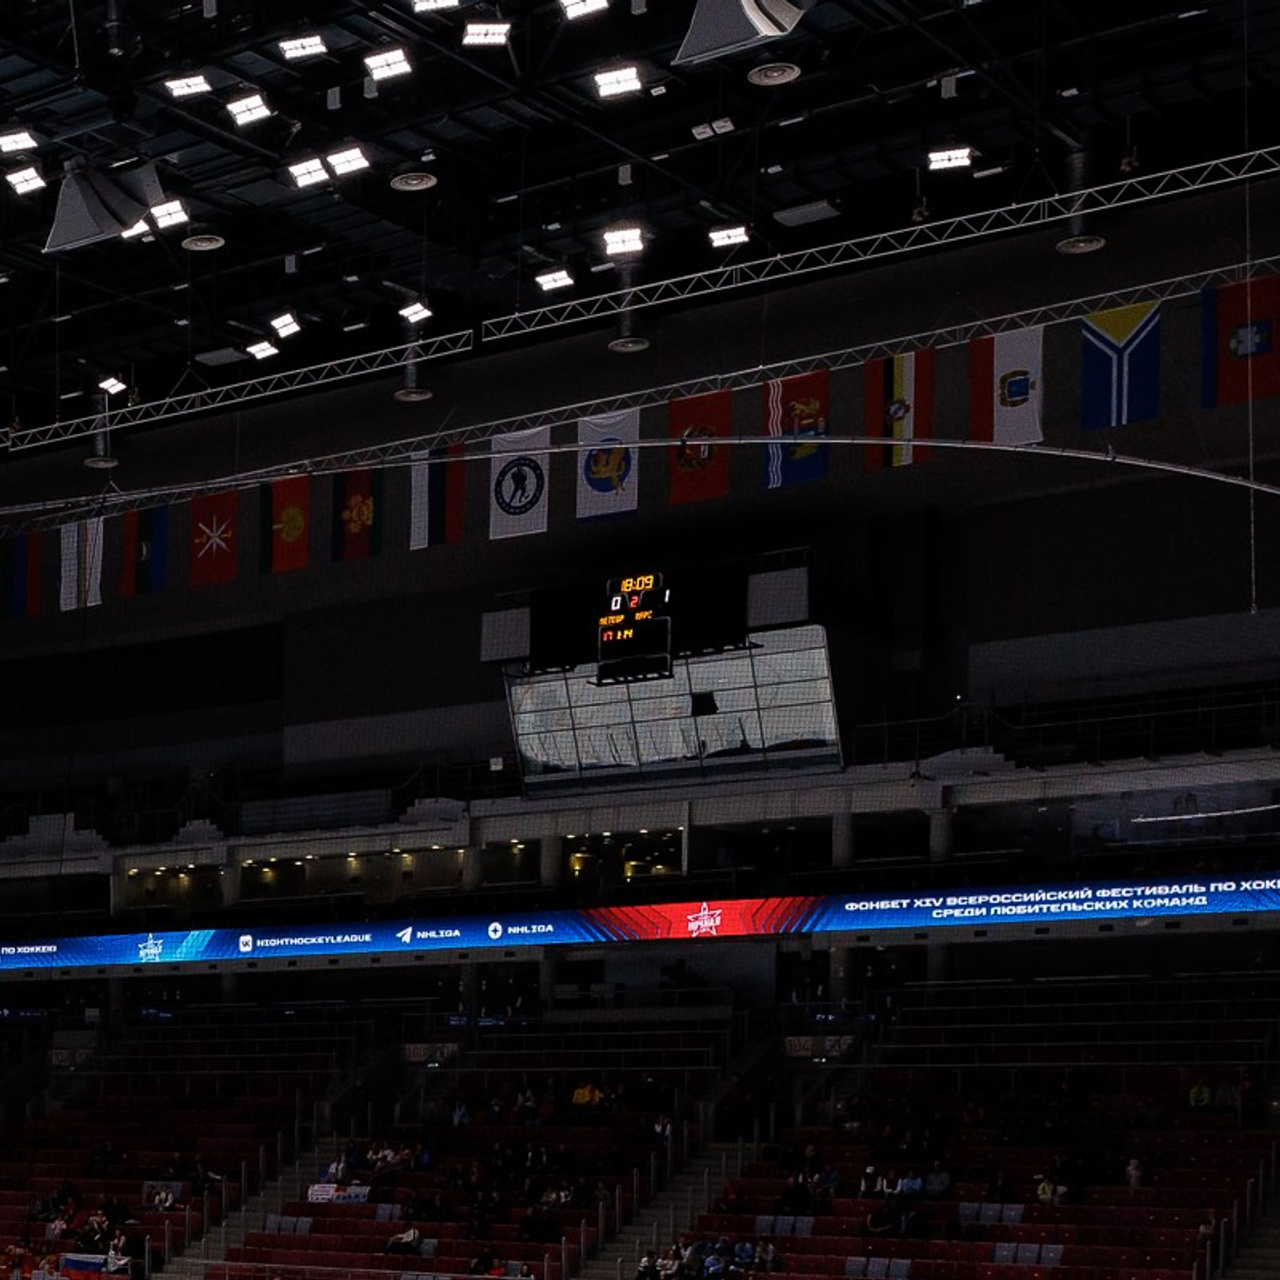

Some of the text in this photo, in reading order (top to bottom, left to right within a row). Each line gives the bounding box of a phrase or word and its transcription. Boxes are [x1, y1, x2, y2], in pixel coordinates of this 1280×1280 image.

[611, 596, 622, 611] 0
[630, 595, 639, 608] 2
[664, 589, 670, 603] 1
[845, 900, 911, 912] ФОНБЕТ
[914, 898, 943, 909] XIV
[945, 888, 1092, 906] ВСЕРОССИЙСКИЙ
[1095, 885, 1206, 899] ФЕСТИВАЛЬ
[1210, 881, 1237, 892] ПО
[932, 896, 1208, 919] СРЕДИ ЛЮБИТЕЛЬСКИХ КОМАНД
[256, 933, 373, 948] NIGHTHOCKEYLEAGUE
[2, 946, 15, 956] ПО
[16, 944, 58, 955] ХОККЕЮ
